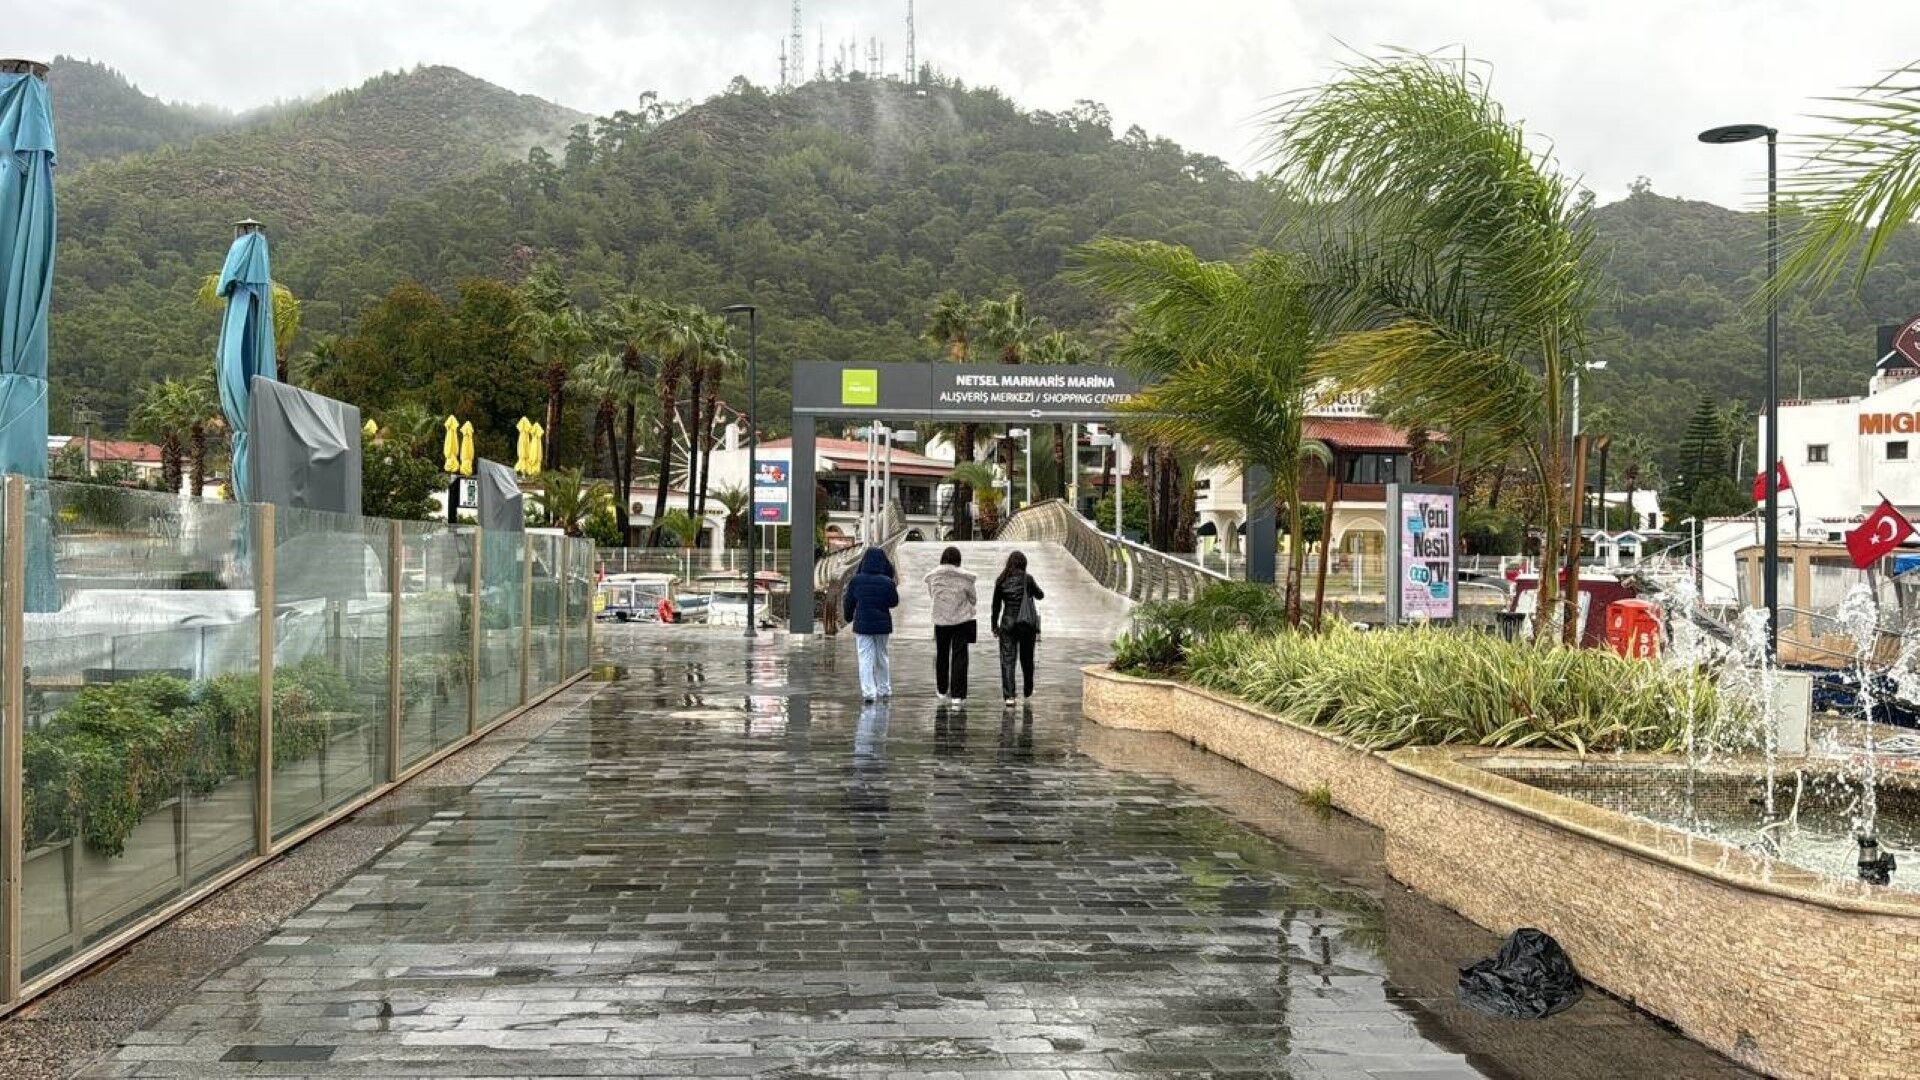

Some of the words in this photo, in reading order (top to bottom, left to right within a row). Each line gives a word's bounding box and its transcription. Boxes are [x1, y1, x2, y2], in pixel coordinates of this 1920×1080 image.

[956, 375, 1000, 386] NETSEL
[1001, 374, 1066, 388] MARMARİS
[1067, 374, 1115, 388] MARİNA
[940, 391, 989, 403] ALIŞVERİŞ
[991, 391, 1034, 403] MERKEZİ
[1043, 393, 1093, 404] SHOPPING
[1419, 502, 1448, 528] Yeni
[1413, 532, 1449, 557] Nesil
